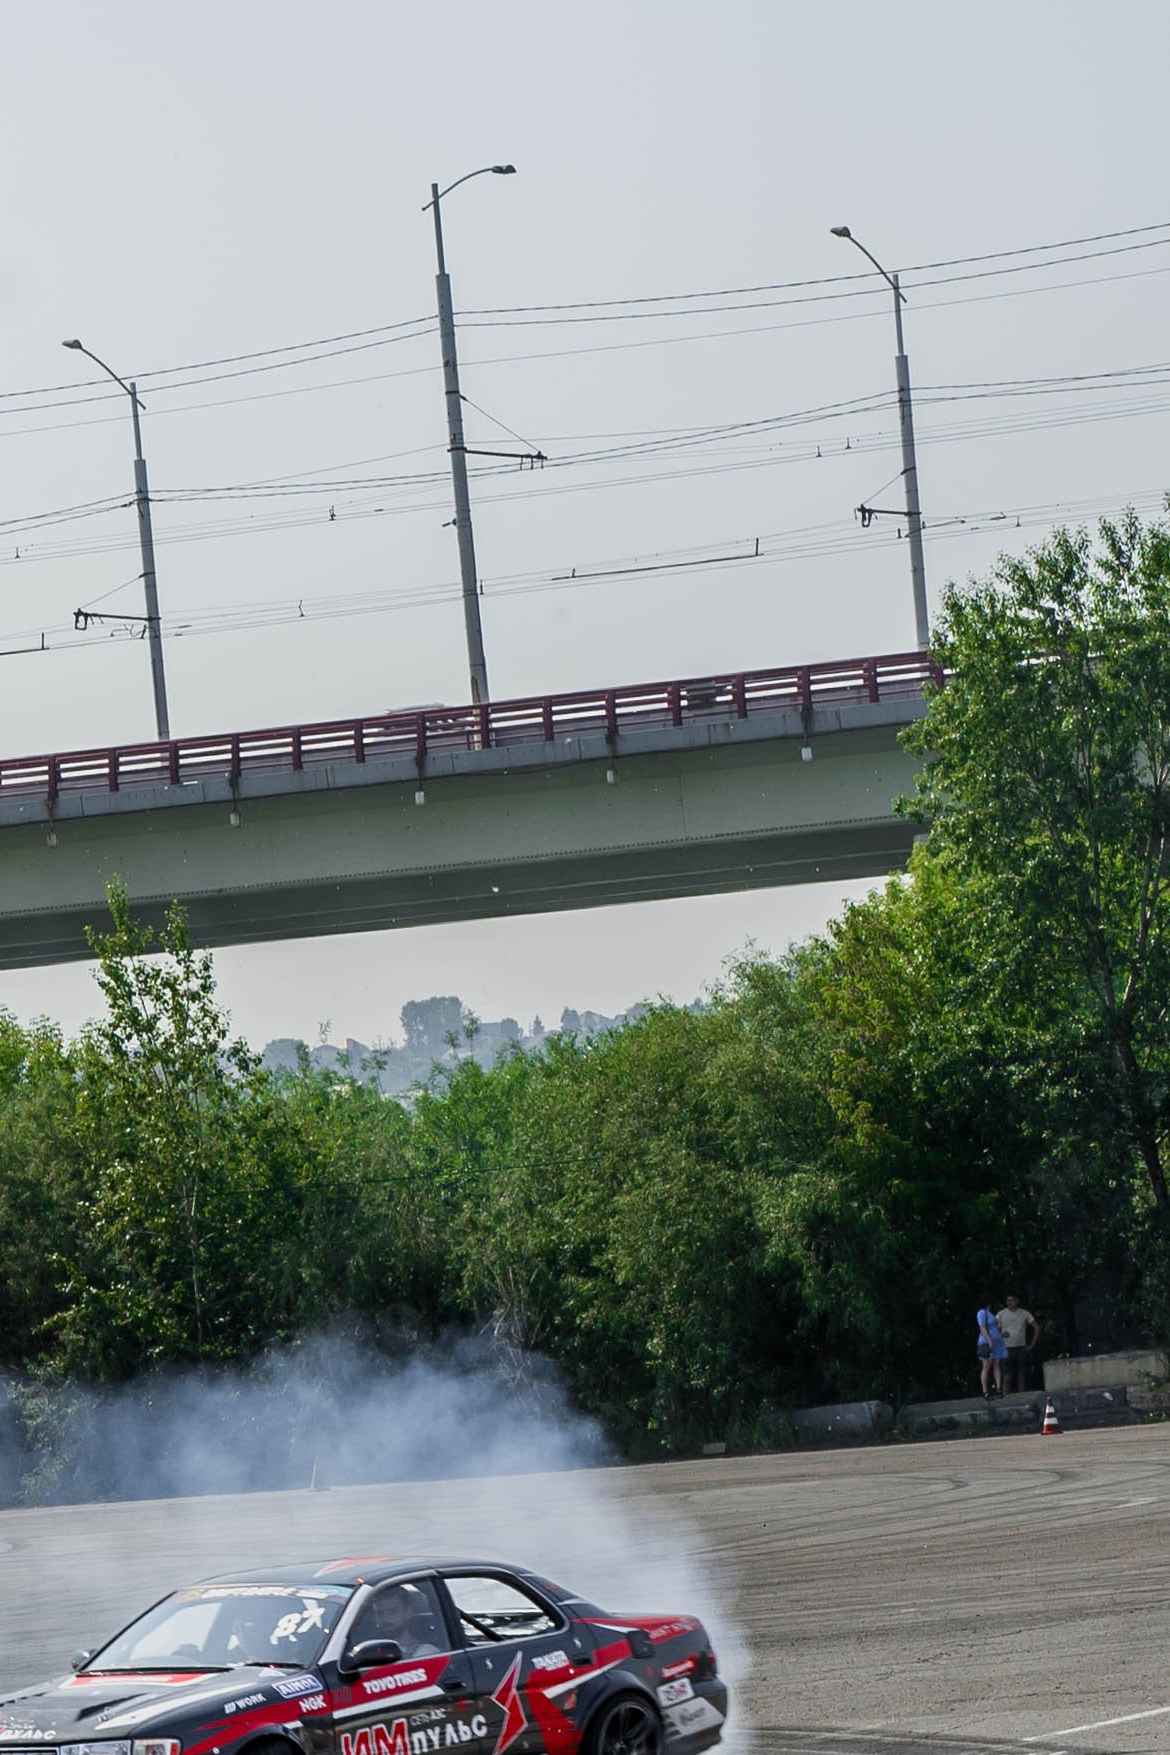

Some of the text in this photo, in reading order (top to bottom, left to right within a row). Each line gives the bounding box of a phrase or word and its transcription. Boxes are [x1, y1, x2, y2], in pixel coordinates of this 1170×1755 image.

[280, 1677, 319, 1696] AIMOL
[363, 1668, 428, 1694] TOYO TIRES
[235, 1693, 267, 1709] WORK
[299, 1695, 327, 1712] NGK
